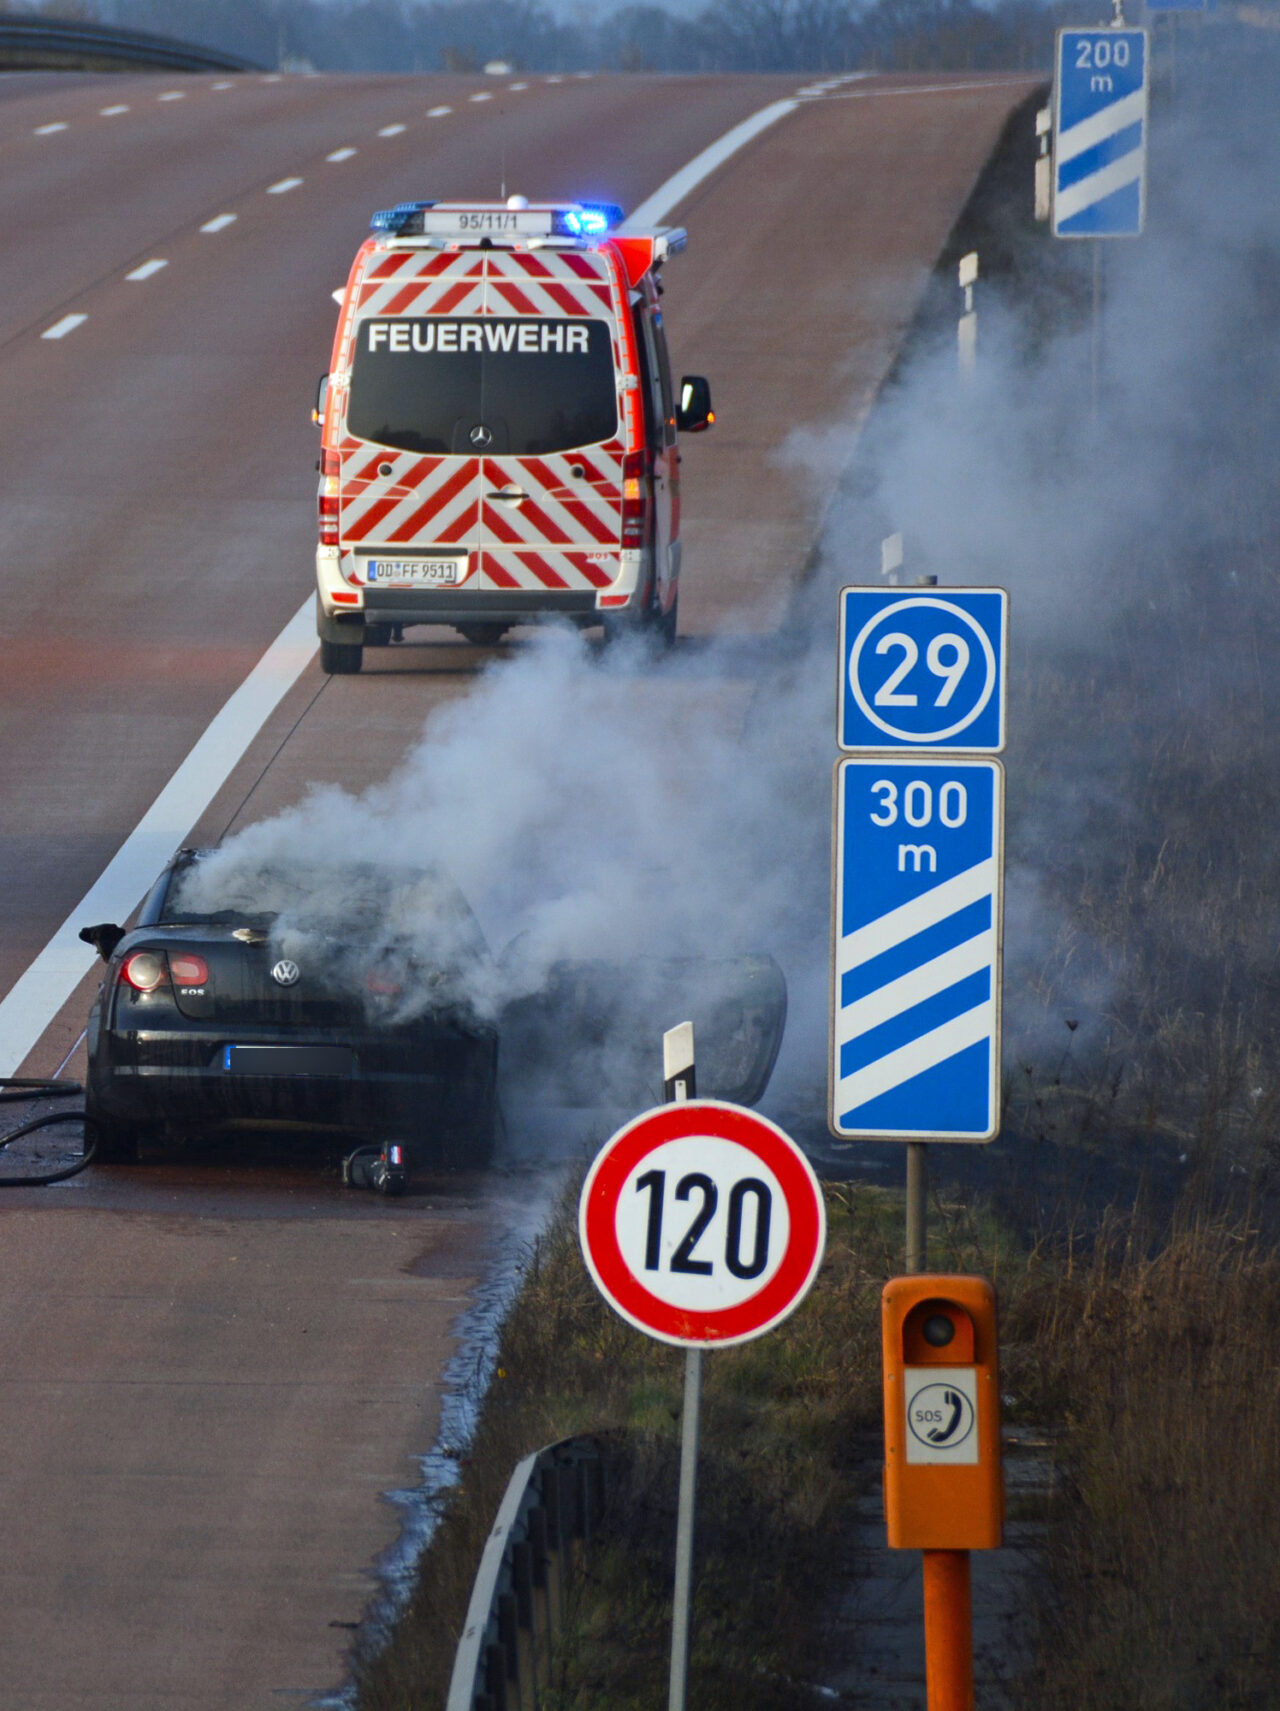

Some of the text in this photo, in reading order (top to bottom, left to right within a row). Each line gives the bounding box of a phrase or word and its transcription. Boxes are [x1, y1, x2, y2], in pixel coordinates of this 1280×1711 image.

[1075, 40, 1129, 69] 200
[1090, 74, 1113, 93] m
[459, 213, 517, 229] 95/11/1
[368, 323, 589, 353] FEUERWEHR
[376, 563, 453, 579] OD FF 9511
[874, 632, 970, 707] 29
[869, 779, 968, 828] 300
[898, 844, 937, 872] m
[636, 1169, 773, 1280] 120
[915, 1409, 943, 1422] SOS
